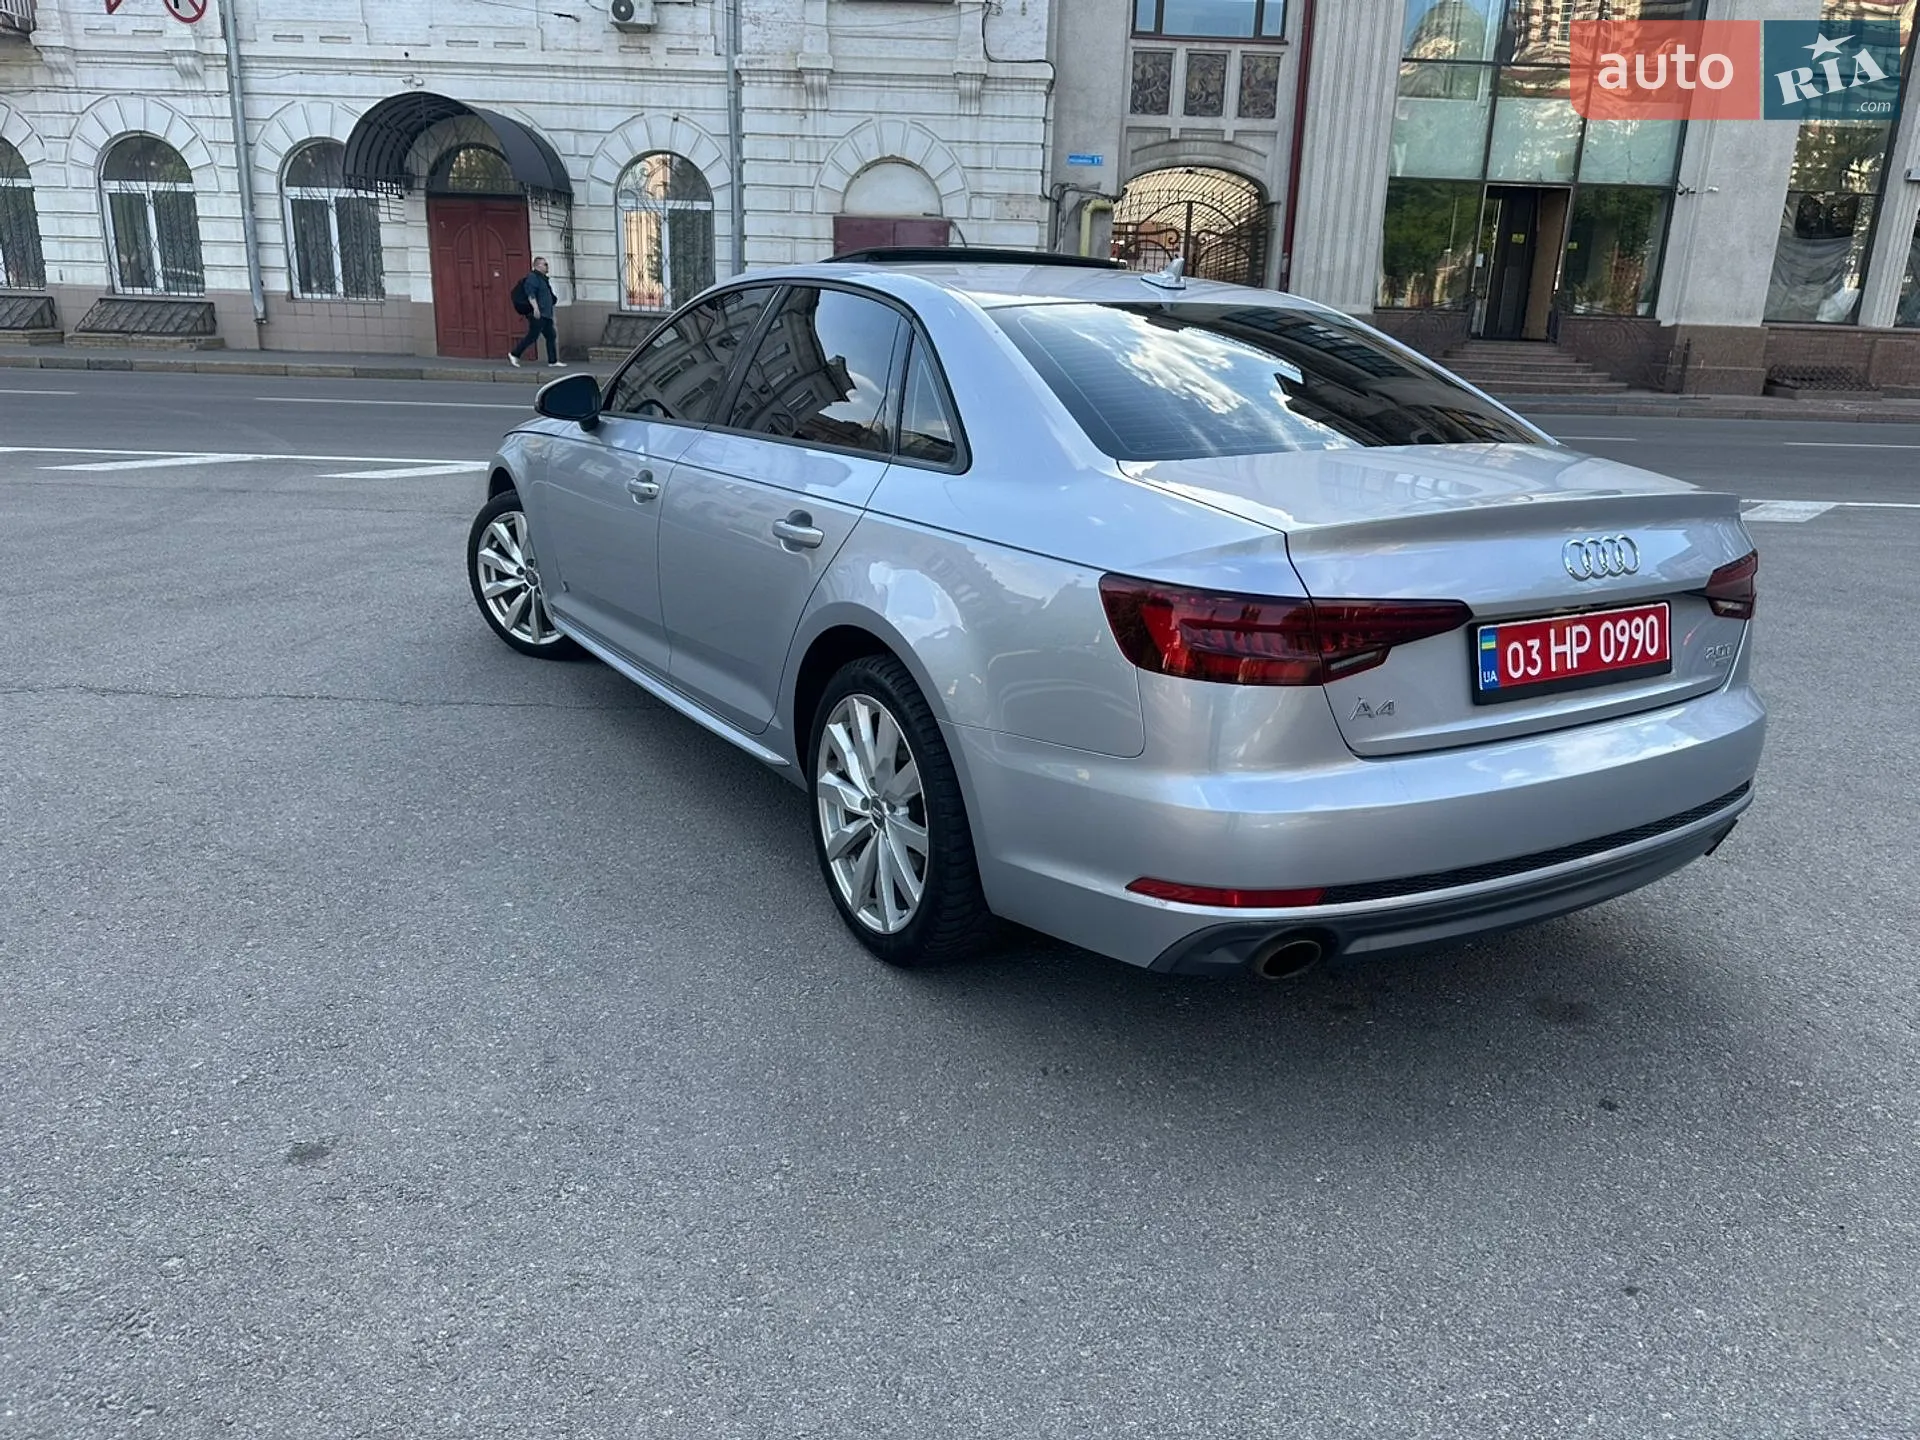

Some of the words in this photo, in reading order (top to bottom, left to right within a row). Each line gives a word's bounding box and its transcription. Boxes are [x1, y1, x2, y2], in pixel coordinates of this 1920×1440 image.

[1506, 638, 1542, 679] 03
[1550, 624, 1591, 672] HP
[1599, 614, 1659, 663] 0990
[1482, 671, 1498, 683] UA
[1348, 696, 1395, 721] A4
